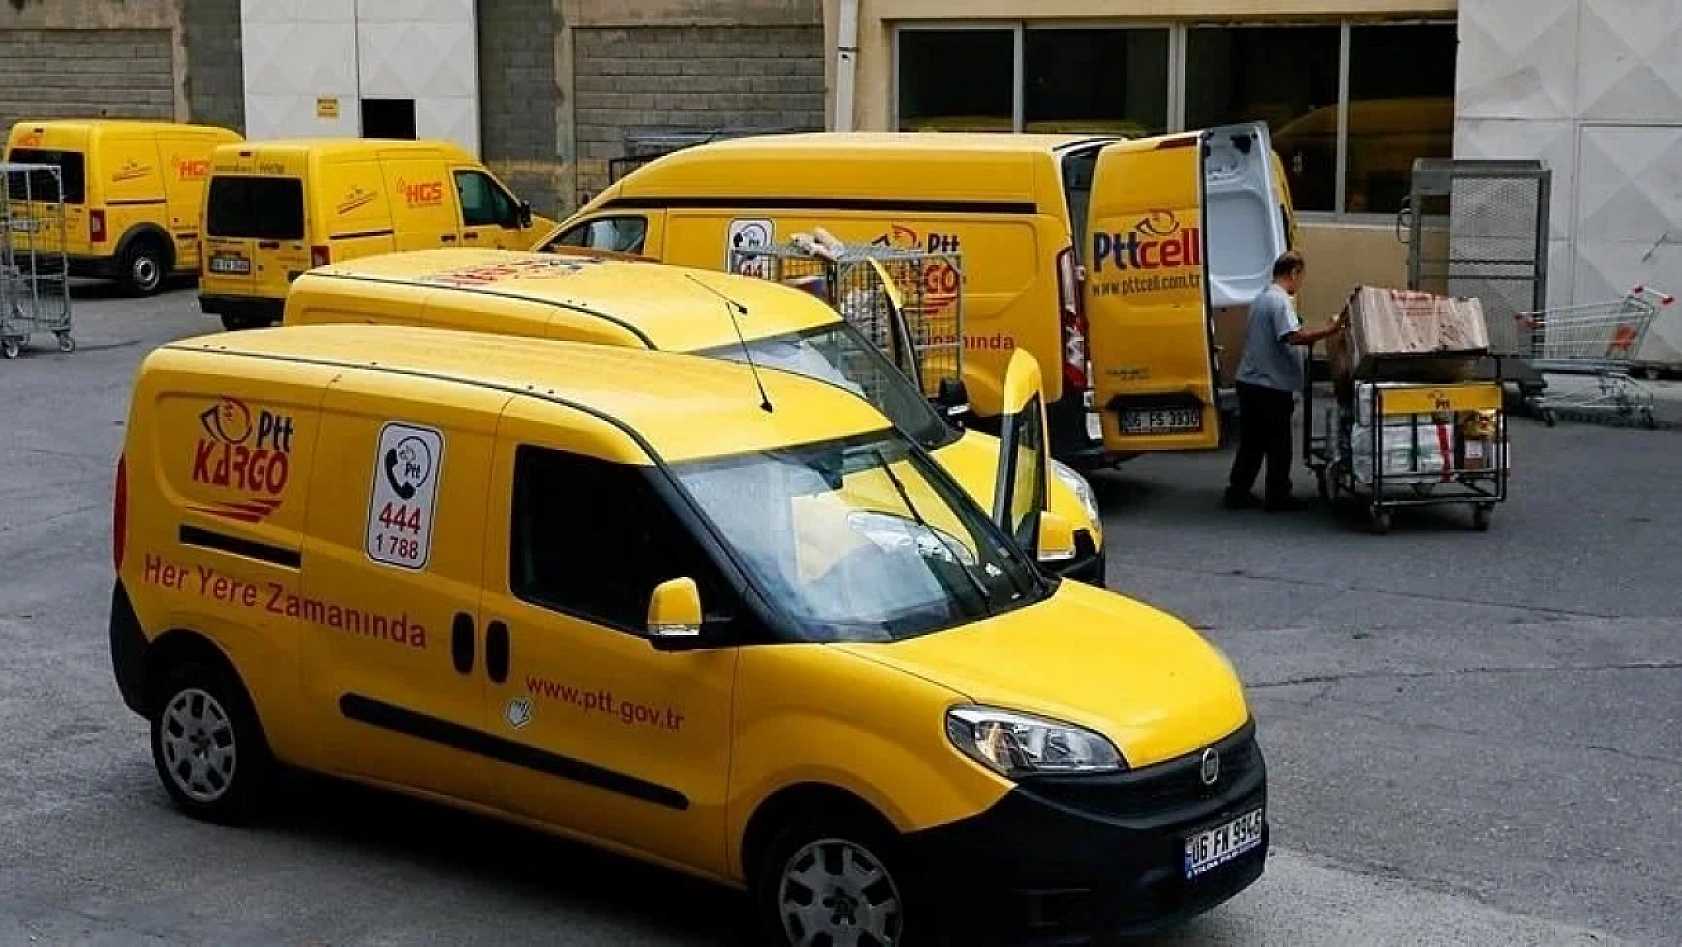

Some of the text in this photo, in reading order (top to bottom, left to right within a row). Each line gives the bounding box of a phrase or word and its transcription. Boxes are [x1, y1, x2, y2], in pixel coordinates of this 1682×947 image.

[406, 181, 442, 203] HGS
[1094, 228, 1201, 272] Pttcell
[257, 410, 294, 454] Ptt
[193, 439, 289, 494] KARGO
[404, 463, 421, 479] Ptt
[379, 501, 421, 535] 444
[376, 533, 418, 560] 1 788
[144, 552, 427, 648] Her Yere Zamanında
[525, 675, 685, 731] www.ptt.gov.tr
